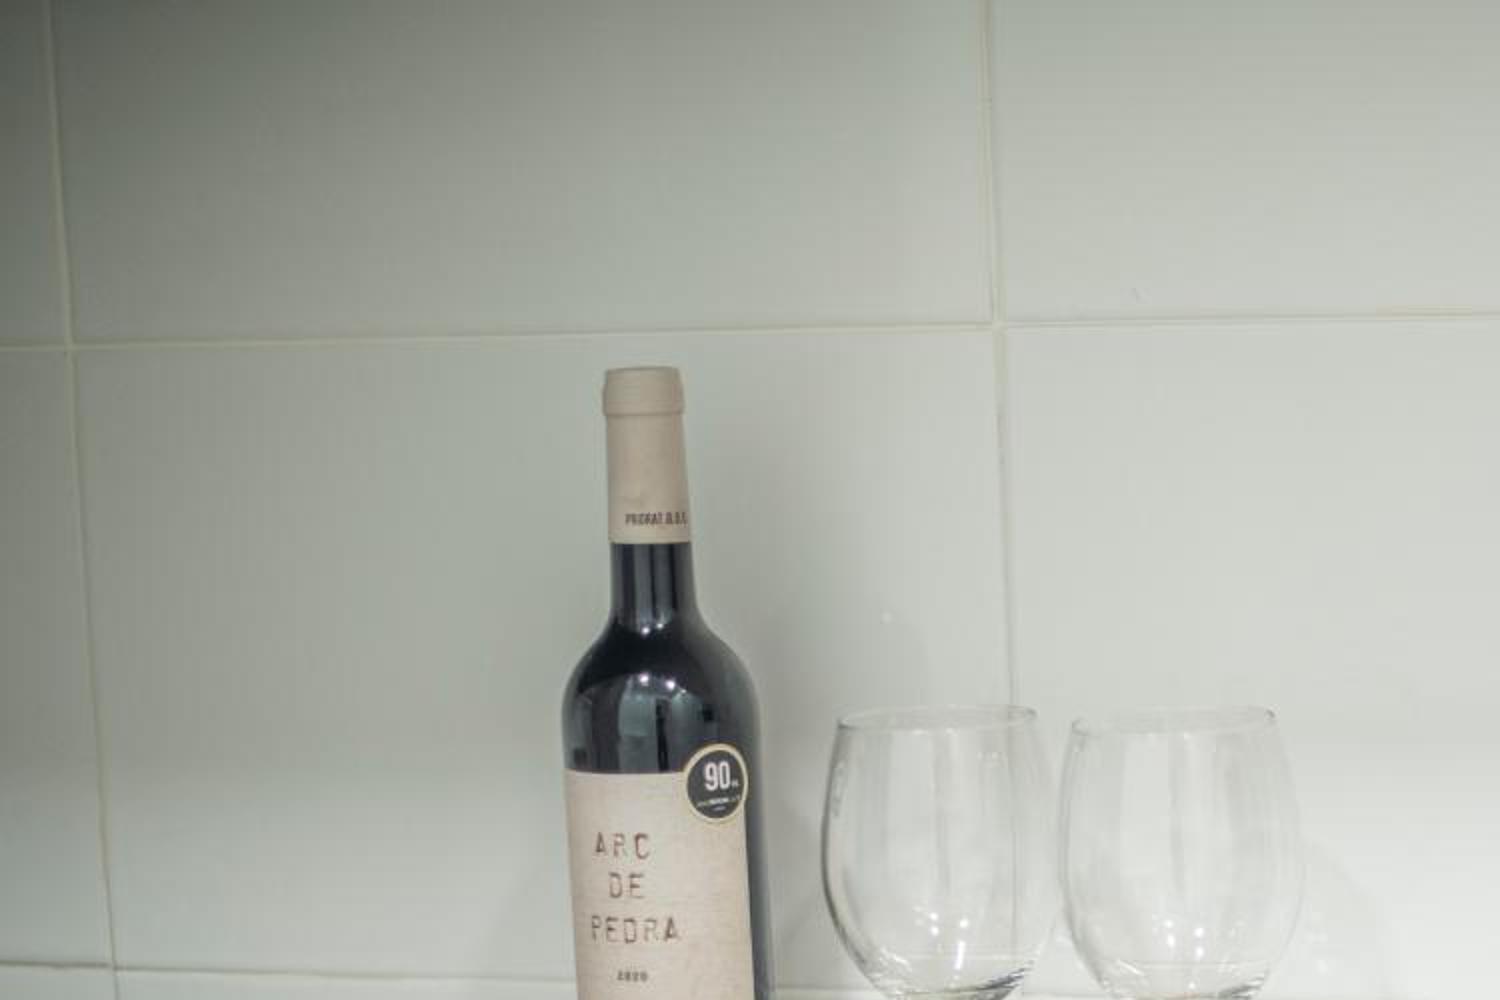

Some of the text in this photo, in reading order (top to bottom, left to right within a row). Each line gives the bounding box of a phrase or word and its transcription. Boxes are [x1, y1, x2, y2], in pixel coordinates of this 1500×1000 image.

[705, 761, 731, 791] 90
[595, 831, 650, 860] ARC
[609, 871, 645, 898] DE
[591, 915, 682, 943] PEDRA
